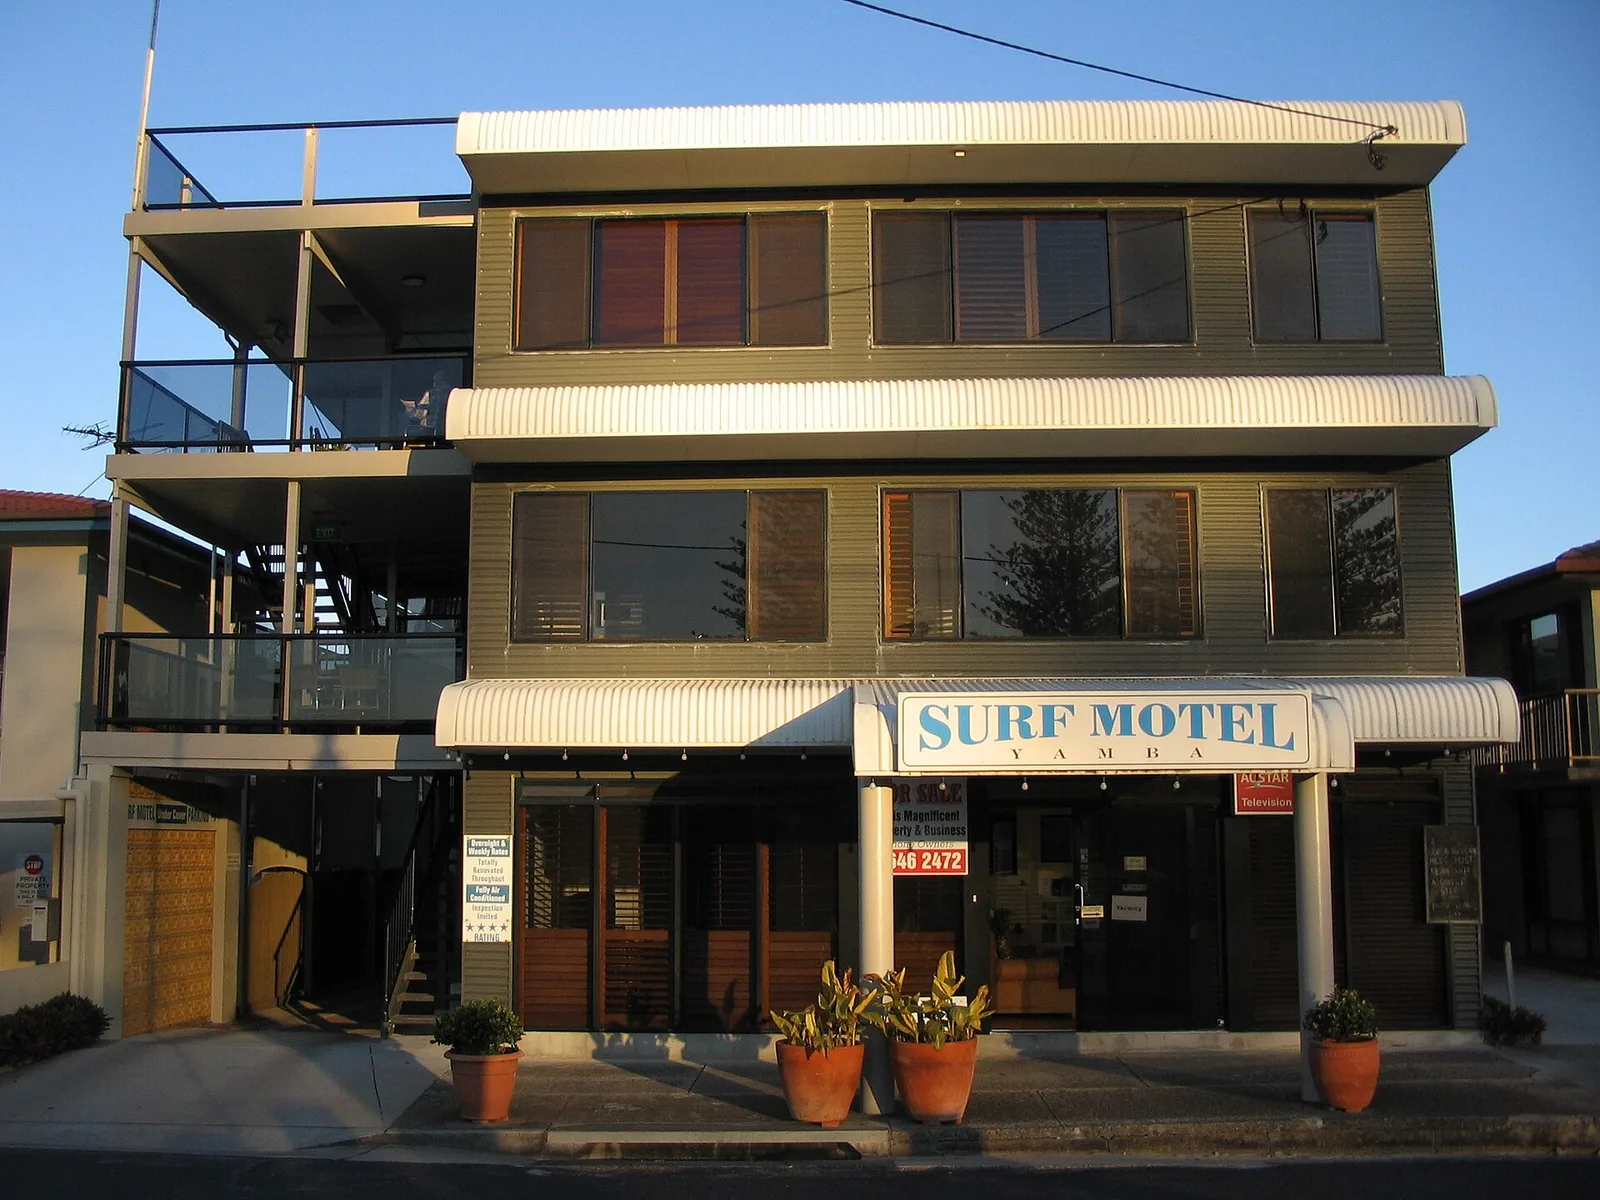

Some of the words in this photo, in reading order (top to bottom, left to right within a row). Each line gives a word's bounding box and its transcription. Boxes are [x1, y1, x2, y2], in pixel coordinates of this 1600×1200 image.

[316, 528, 335, 538] EXIT
[919, 703, 1075, 752] SURF
[1089, 702, 1296, 752] MOTEL
[1011, 746, 1204, 760] YAMBA
[916, 783, 962, 804] SALE
[1241, 797, 1292, 807] Television
[157, 808, 172, 819] Under
[173, 809, 186, 820] Cover
[904, 810, 960, 822] Magnificent
[914, 825, 921, 836] &
[924, 825, 966, 836] Business
[471, 839, 500, 848] Overnight
[501, 839, 507, 847] &
[917, 840, 955, 848] Owners
[468, 847, 490, 856] Weekly
[26, 860, 42, 869] STOP
[478, 858, 498, 867] Totally
[921, 852, 962, 869] 2472
[471, 875, 505, 883] Throughout
[475, 885, 490, 894] Fully
[491, 886, 500, 894] Air
[470, 894, 506, 902] Conditioned
[472, 904, 503, 912] Inspection
[474, 933, 500, 942] RATING
